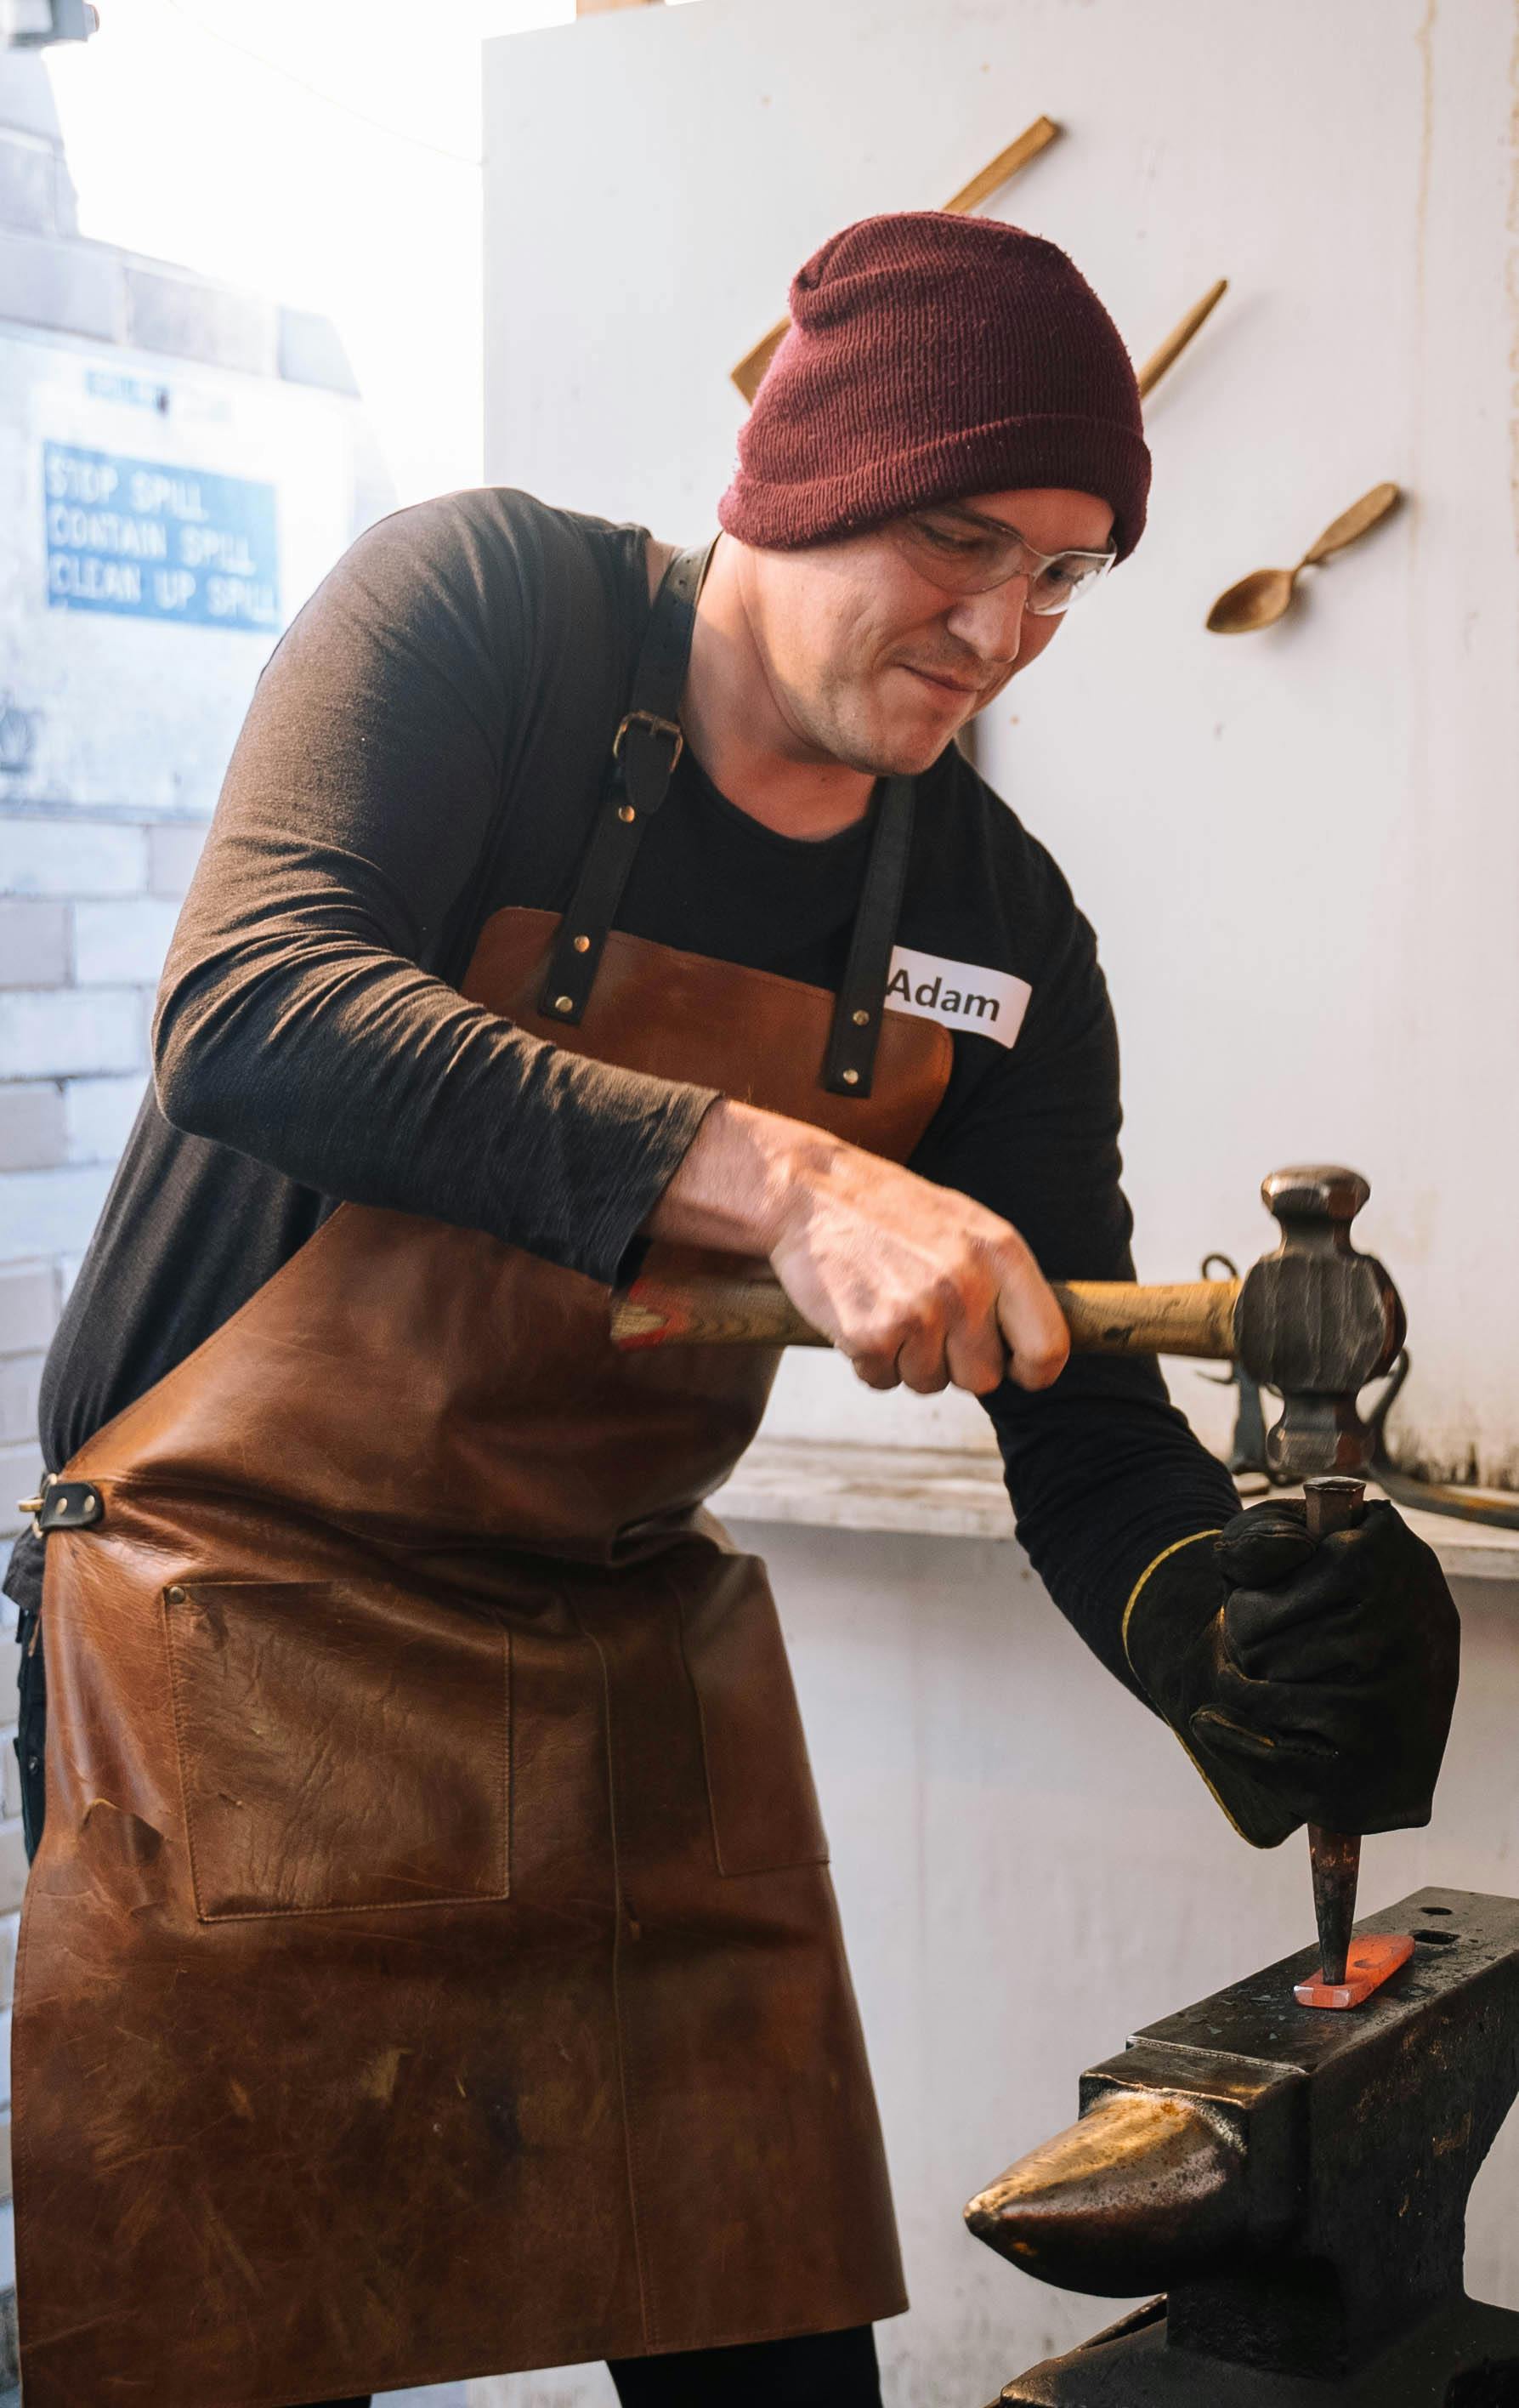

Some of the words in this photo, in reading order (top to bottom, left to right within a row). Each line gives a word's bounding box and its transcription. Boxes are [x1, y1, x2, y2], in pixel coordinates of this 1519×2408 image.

[48, 455, 119, 504] STOP
[130, 471, 209, 522] SPILL
[49, 503, 167, 561] CONTAIN
[179, 525, 255, 576] SPILL
[49, 554, 141, 605] CLEAN
[153, 570, 196, 611] UP
[207, 576, 276, 624] SPILL
[886, 968, 1000, 1021] Adam
